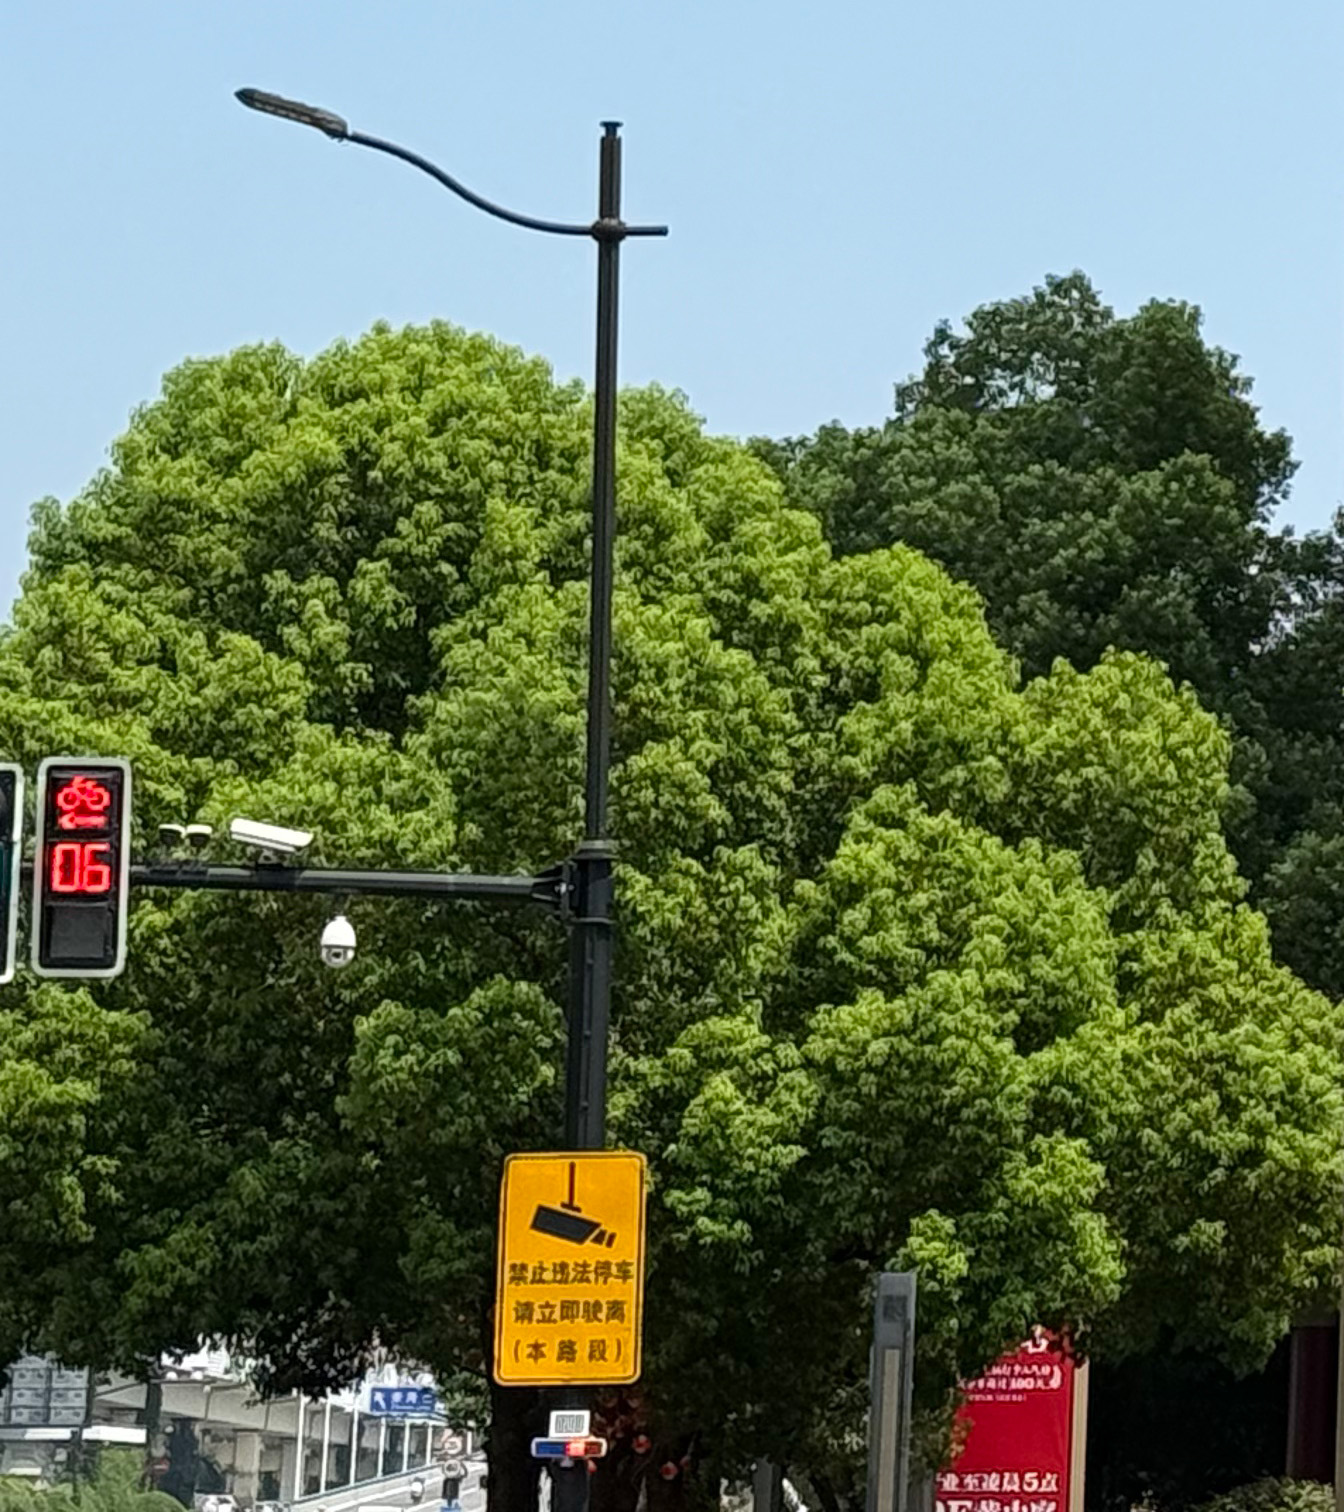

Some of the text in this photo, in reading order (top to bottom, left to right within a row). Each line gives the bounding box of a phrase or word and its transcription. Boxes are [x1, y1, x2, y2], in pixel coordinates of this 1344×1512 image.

[51, 842, 111, 893] 06
[509, 1260, 634, 1285] 禁止违法停车
[513, 1299, 626, 1325] 请立即驶离
